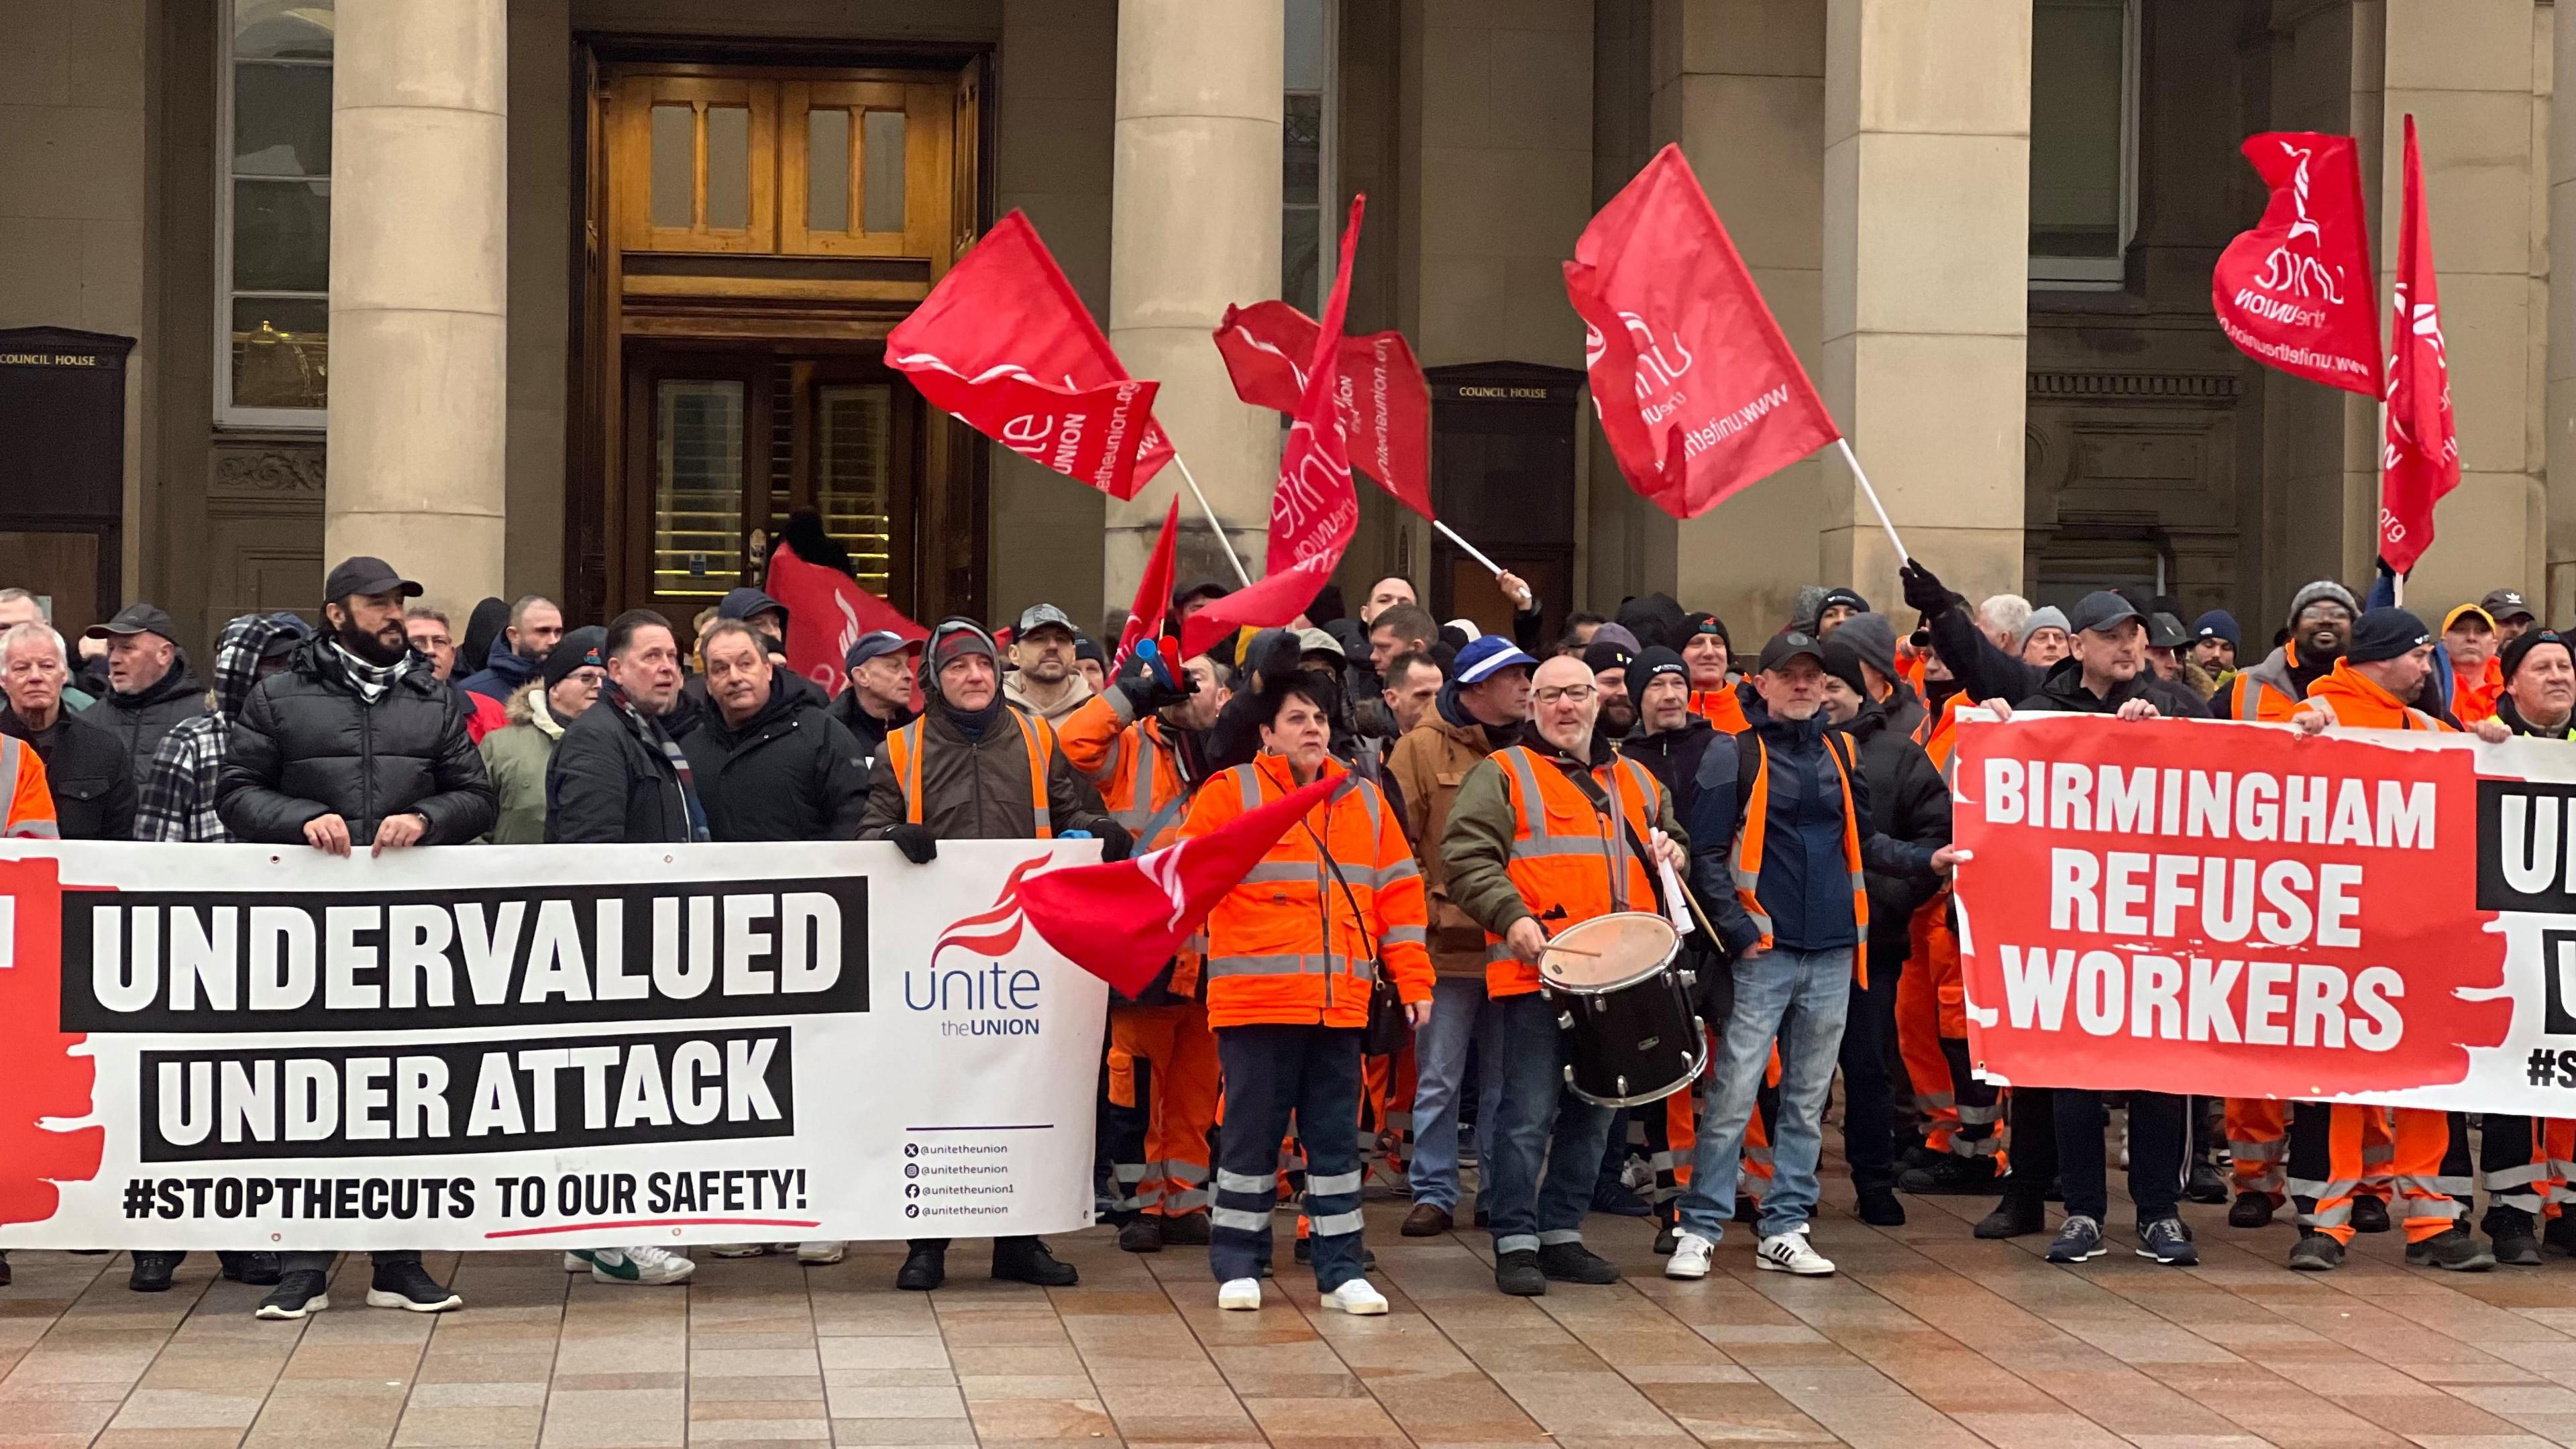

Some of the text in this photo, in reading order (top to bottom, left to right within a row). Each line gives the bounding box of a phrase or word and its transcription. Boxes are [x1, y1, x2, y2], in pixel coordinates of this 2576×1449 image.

[0, 354, 96, 366] COUNCIL HOUSE
[1459, 387, 1546, 398] COUNCIL HOUSE
[1985, 758, 2436, 850] BIRMINGHAM
[2050, 848, 2363, 948] REFUSE
[92, 892, 841, 1012] UNDERVALUED
[905, 962, 1040, 1011] unite
[2000, 945, 2404, 1052] WORKERS
[158, 1038, 782, 1146] UNDER ATTACK
[920, 1144, 1008, 1155] @unitetheunion
[921, 1164, 1008, 1175] @unitetheunion
[123, 1169, 806, 1220] #STOPTHECUTS TO OUR SAFETY!
[922, 1184, 1014, 1195] @unitetheunion1
[922, 1205, 1008, 1216] @unitetheunion
